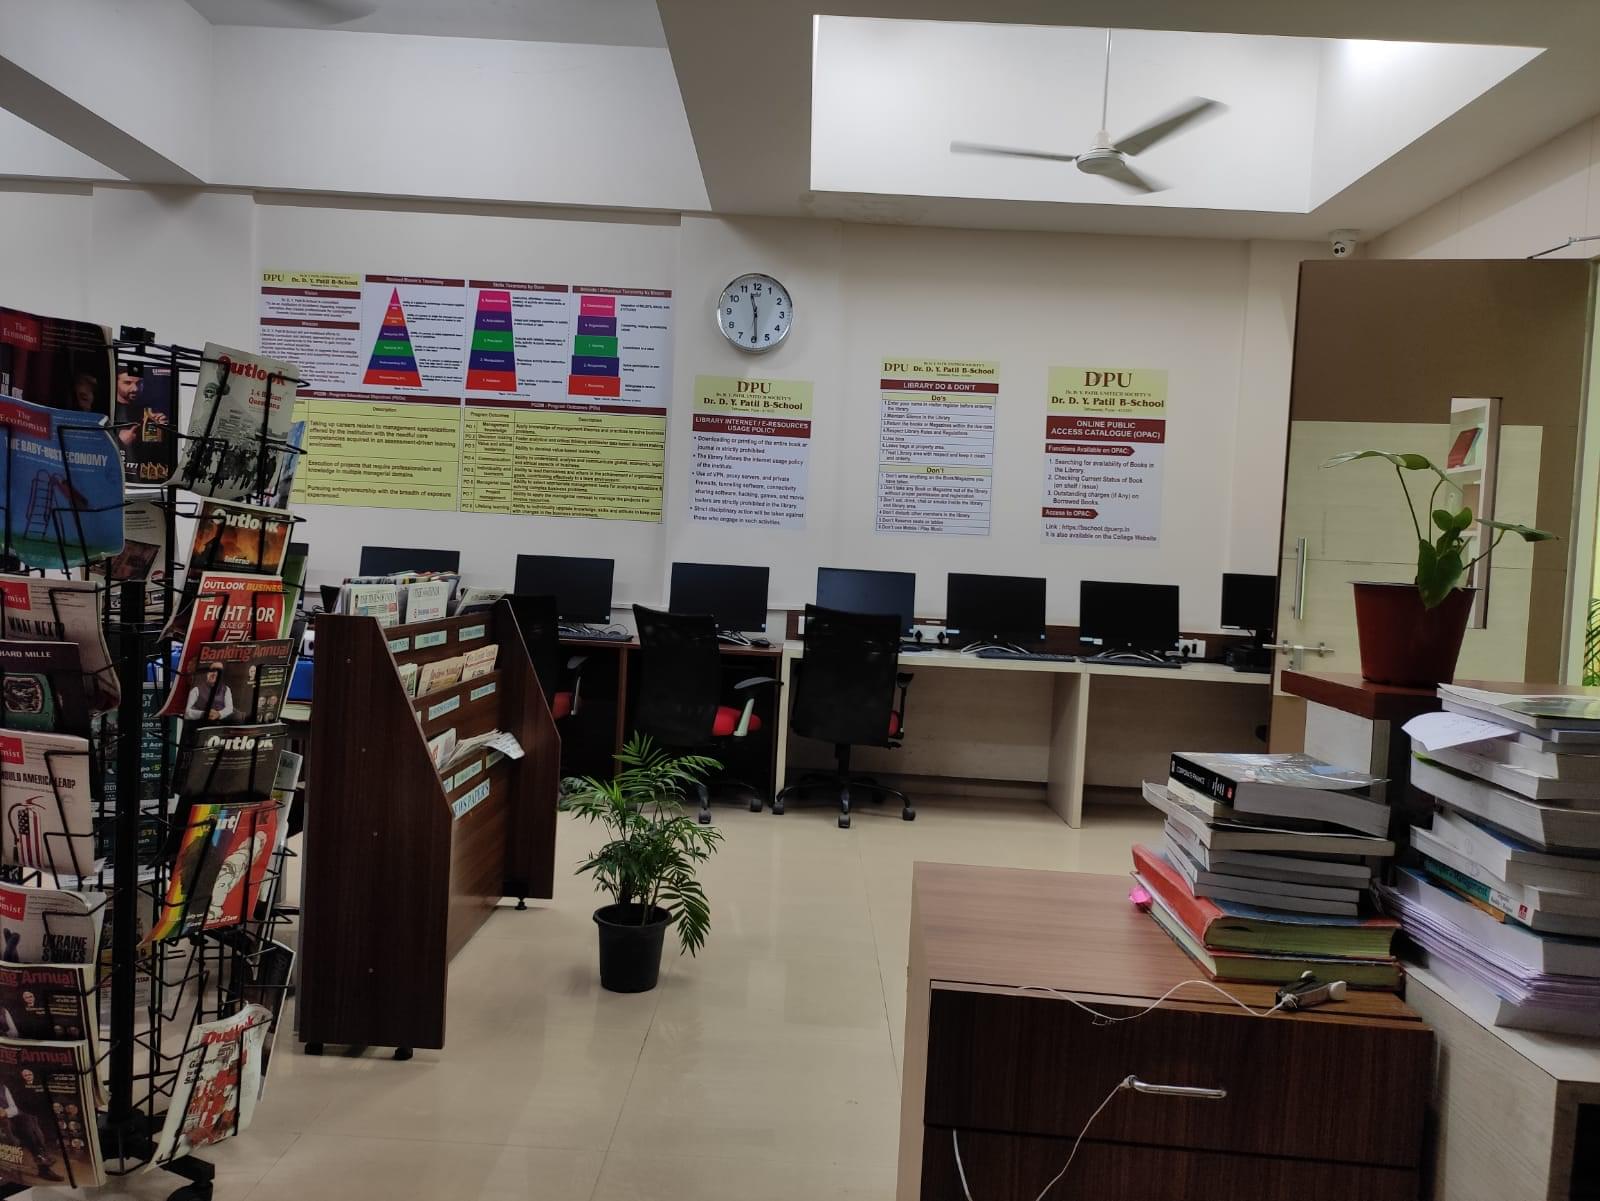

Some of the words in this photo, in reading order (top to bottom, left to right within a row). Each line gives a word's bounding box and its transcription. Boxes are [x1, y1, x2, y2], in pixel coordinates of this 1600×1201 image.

[263, 273, 285, 282] DPU
[741, 285, 748, 293] 11
[768, 287, 772, 295] 1
[730, 295, 740, 303] 10
[776, 297, 782, 306] 2
[779, 311, 785, 319] 3
[15, 322, 27, 332] The
[728, 321, 735, 329] 8
[774, 324, 780, 332] 4
[3, 328, 38, 345] Economist
[764, 333, 770, 341] 5
[884, 362, 909, 372] DPU
[943, 366, 960, 374] Patil
[962, 367, 995, 375] B-School
[1084, 371, 1133, 388] DPU
[737, 380, 772, 394] DPU
[903, 381, 932, 390] LIBRARY
[935, 383, 945, 391] DO
[954, 383, 976, 391] DON'T
[931, 394, 947, 402] Do's
[1051, 396, 1065, 405] Dr.
[1068, 397, 1079, 405] D.
[1083, 397, 1089, 406] Y.
[1093, 397, 1116, 407] Patil
[1119, 398, 1165, 408] B-School
[248, 397, 280, 411] Quesons
[703, 397, 717, 405] Dr.
[740, 399, 760, 408] Patil
[763, 400, 804, 410] B-School
[16, 408, 32, 421] The
[0, 415, 48, 434] Economist
[695, 416, 724, 425] LIBRARY
[726, 418, 757, 427] INTERNET
[762, 420, 809, 429] E-RESOURCES
[1076, 419, 1105, 429] ONLINE
[1107, 421, 1137, 430] PUBLIC
[727, 425, 751, 433] USAGE
[751, 426, 776, 434] POLICY
[1051, 427, 1083, 436] ACCESS
[1085, 428, 1132, 438] CATALOGUE
[1133, 431, 1161, 440] (OPAC)
[21, 440, 63, 463] BABY-BUST
[65, 450, 109, 468] ECONOMY
[1111, 447, 1129, 455] OPAC
[1055, 459, 1082, 468] Searching
[1093, 460, 1121, 469] availability
[1130, 461, 1147, 469] Books
[1054, 474, 1080, 483] Checking
[1081, 475, 1102, 483] Current
[1053, 482, 1063, 490] (on
[1082, 483, 1099, 491] issue)
[1054, 490, 1087, 499] Outstanding
[1088, 492, 1110, 501] charges
[1053, 497, 1080, 506] Borrowed
[1046, 508, 1066, 517] Access
[212, 507, 280, 535] Outlok
[1046, 522, 1057, 531] Link
[1057, 531, 1068, 539] also
[1070, 532, 1094, 540] available
[1113, 534, 1134, 543] College
[203, 580, 245, 592] OUTLOOK
[8, 615, 33, 640] WHAT
[24, 651, 52, 660] MILLE
[201, 647, 252, 664] Banking
[255, 643, 289, 658] Annual
[207, 735, 274, 752] Outlok
[55, 777, 77, 791] LEAD?
[22, 969, 75, 988] Annual
[22, 1046, 74, 1064] Annual
